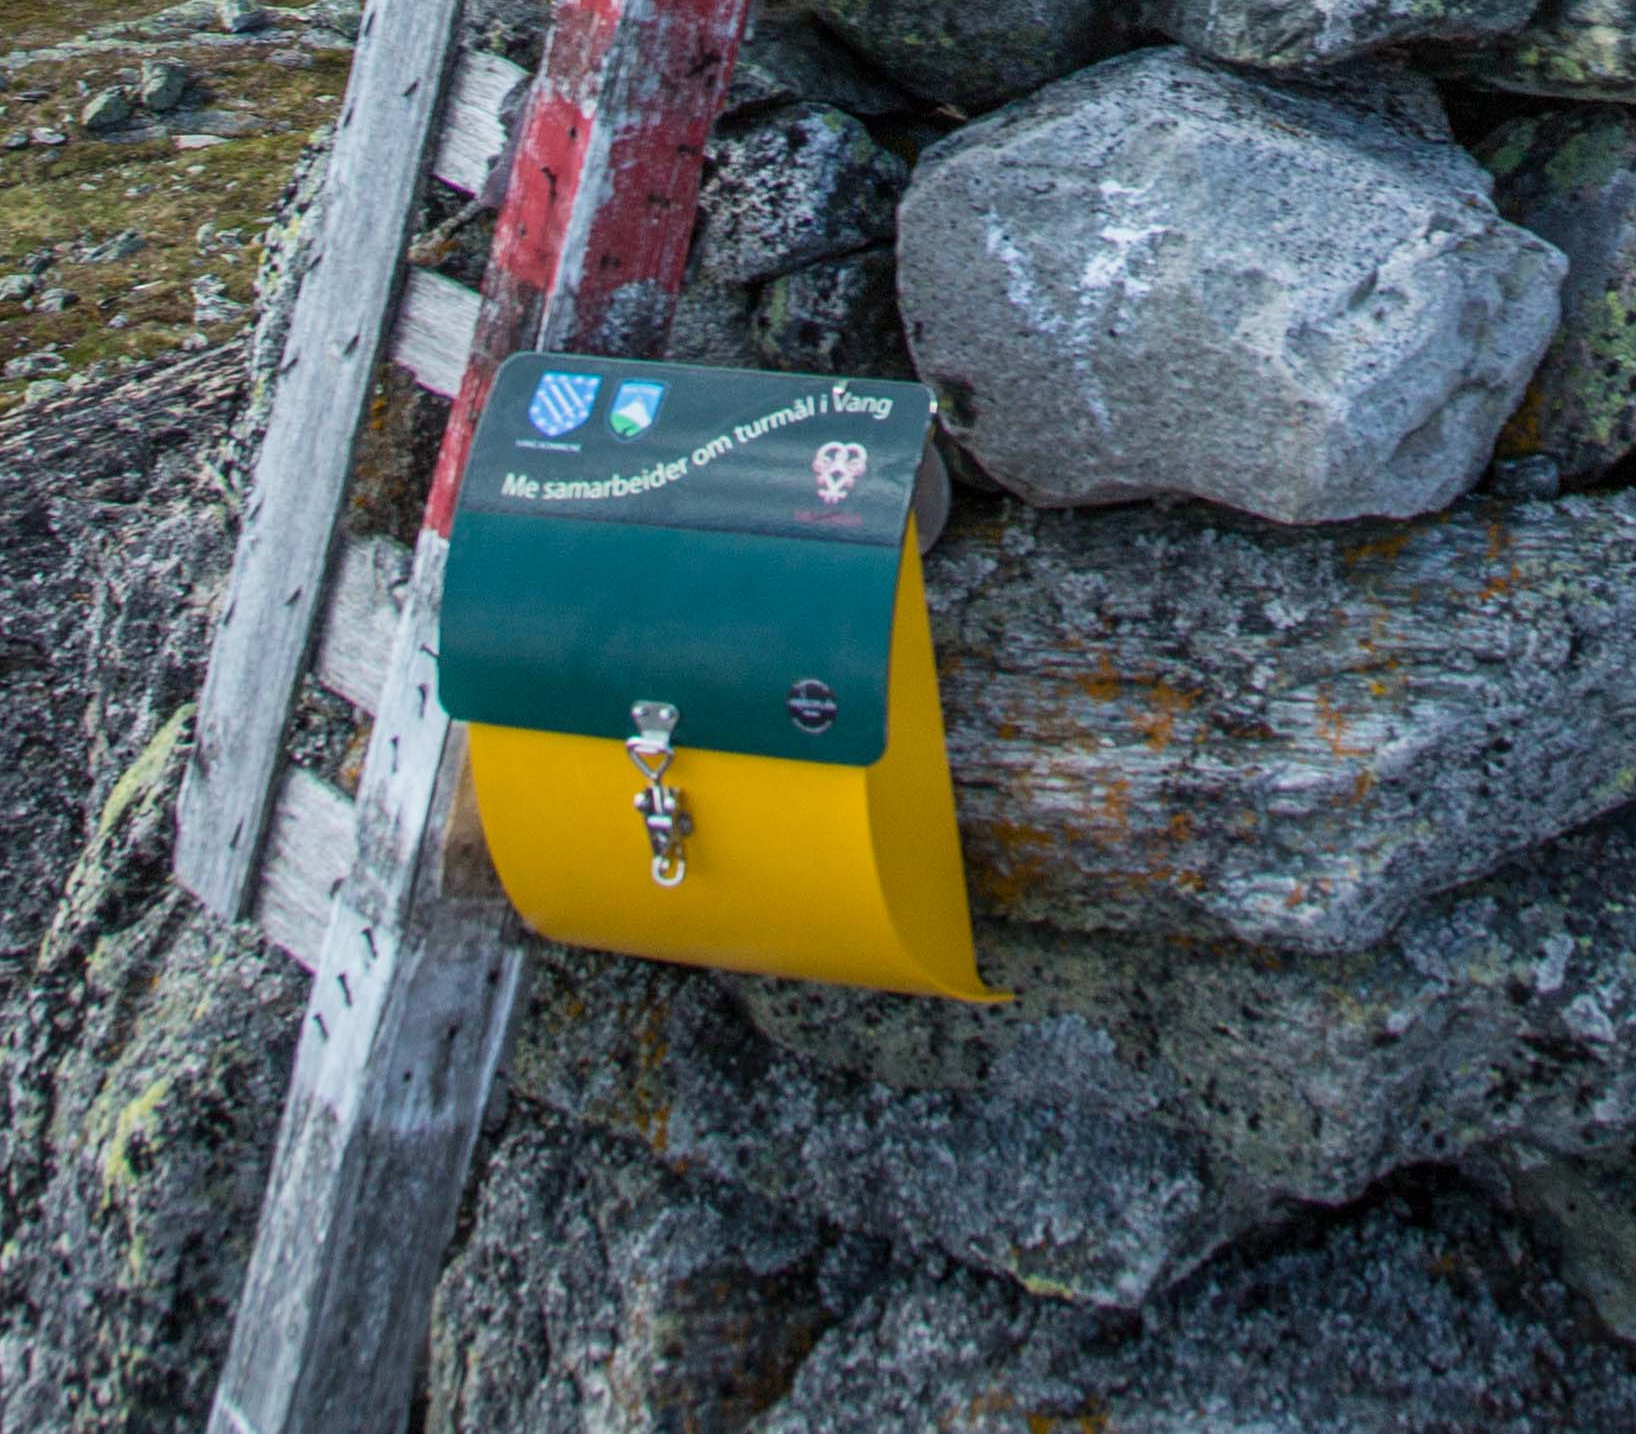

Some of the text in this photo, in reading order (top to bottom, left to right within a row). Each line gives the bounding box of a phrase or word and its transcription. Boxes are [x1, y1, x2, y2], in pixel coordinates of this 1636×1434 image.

[501, 391, 894, 500] Me samarbeider om turmål i Vang
